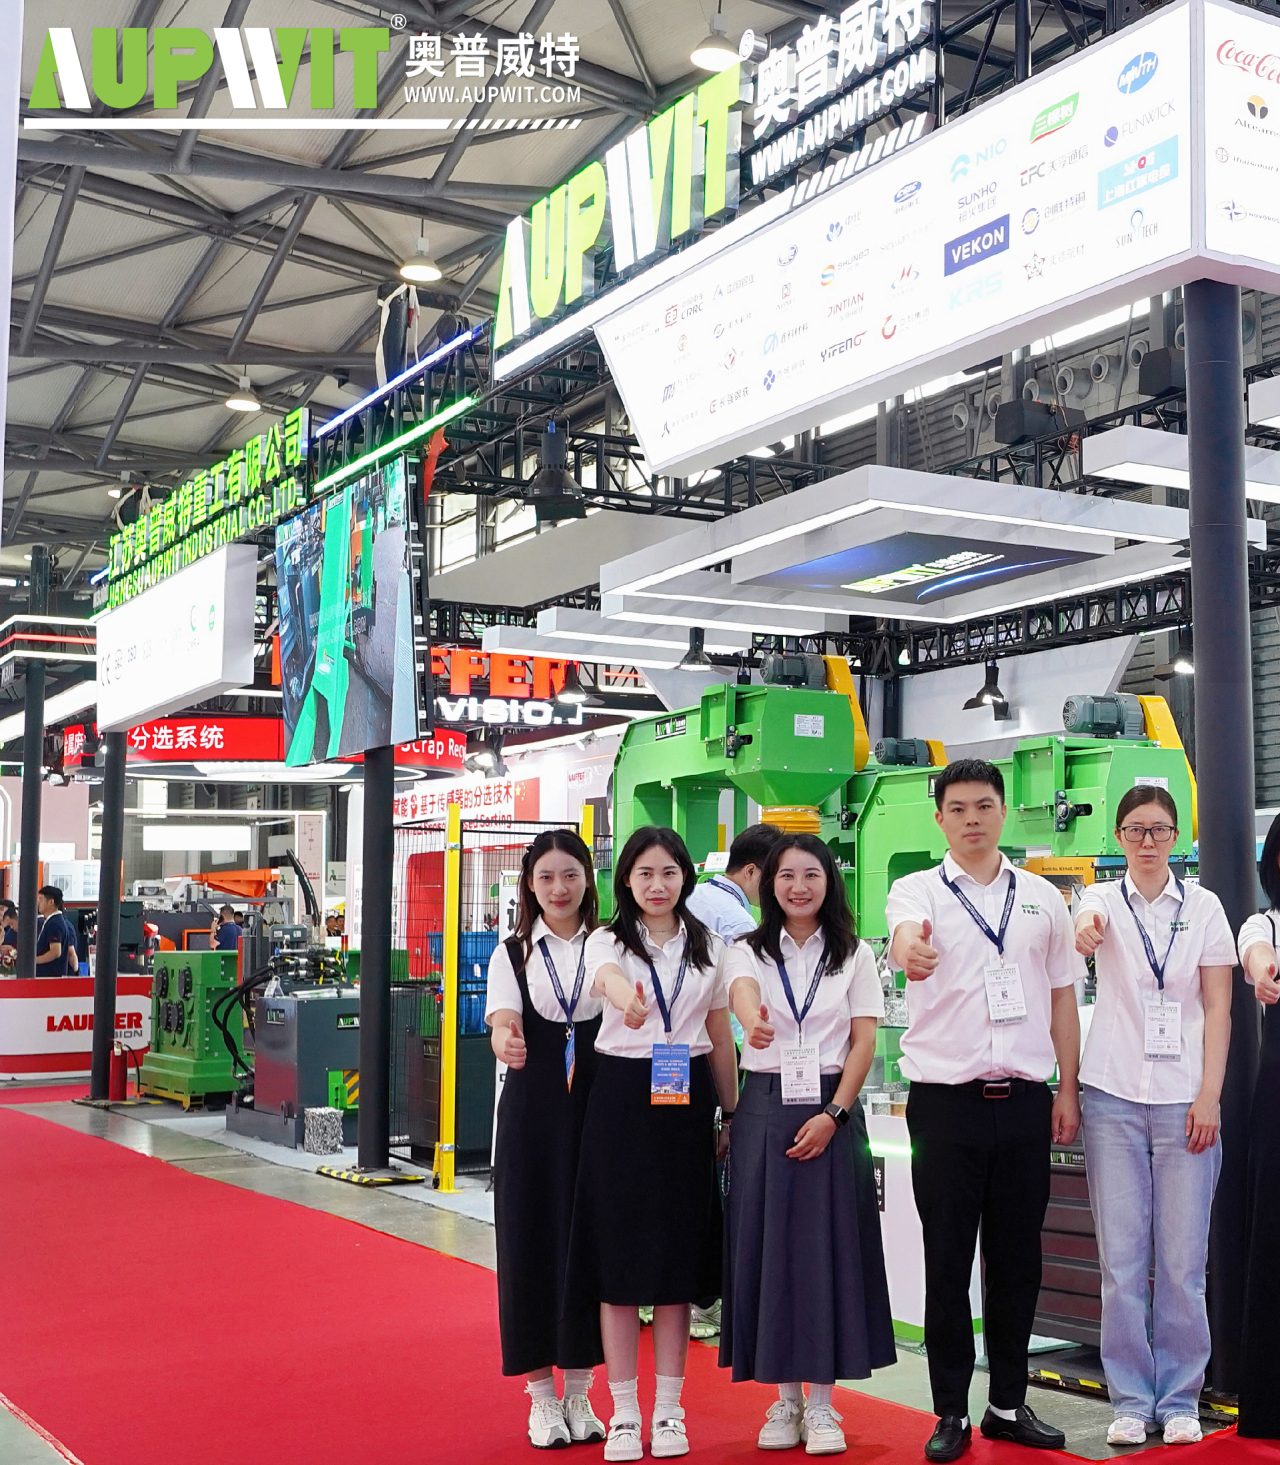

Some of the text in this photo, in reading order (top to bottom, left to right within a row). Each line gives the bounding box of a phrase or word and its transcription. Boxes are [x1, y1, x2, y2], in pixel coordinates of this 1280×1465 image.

[751, 48, 927, 185] WWW.AUPWIT.COM
[976, 138, 1008, 168] NIO
[493, 62, 740, 350] AUPWIT
[951, 226, 1005, 264] VEKON
[108, 406, 304, 580] 江苏奥普威特重工有限公司
[182, 505, 245, 567] INDUSTRIAL
[46, 1012, 143, 1033] LAUER
